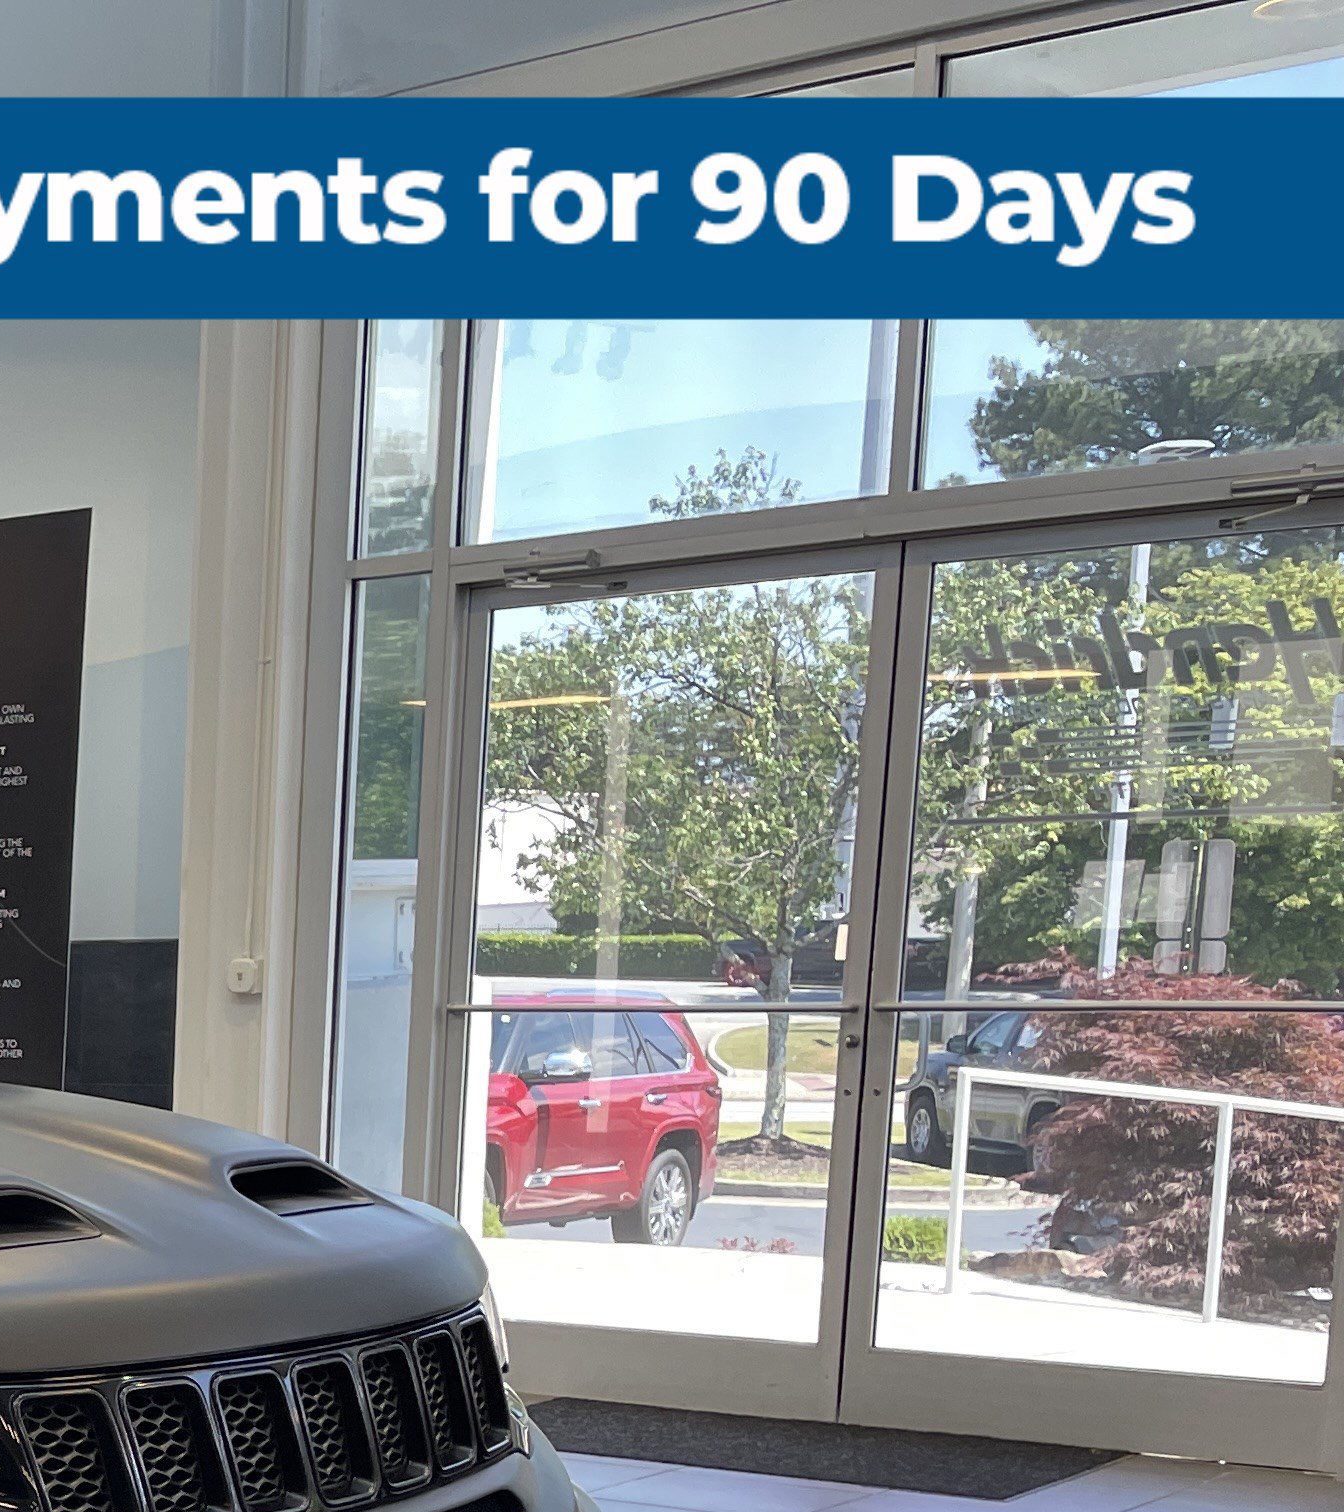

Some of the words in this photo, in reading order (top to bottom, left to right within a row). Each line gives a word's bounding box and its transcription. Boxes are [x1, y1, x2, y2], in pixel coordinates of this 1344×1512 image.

[1, 704, 25, 715] OWN
[0, 713, 35, 725] LASTING
[3, 765, 23, 776] AND
[7, 837, 24, 848] THE
[2, 978, 22, 989] AND
[5, 1038, 18, 1048] TO
